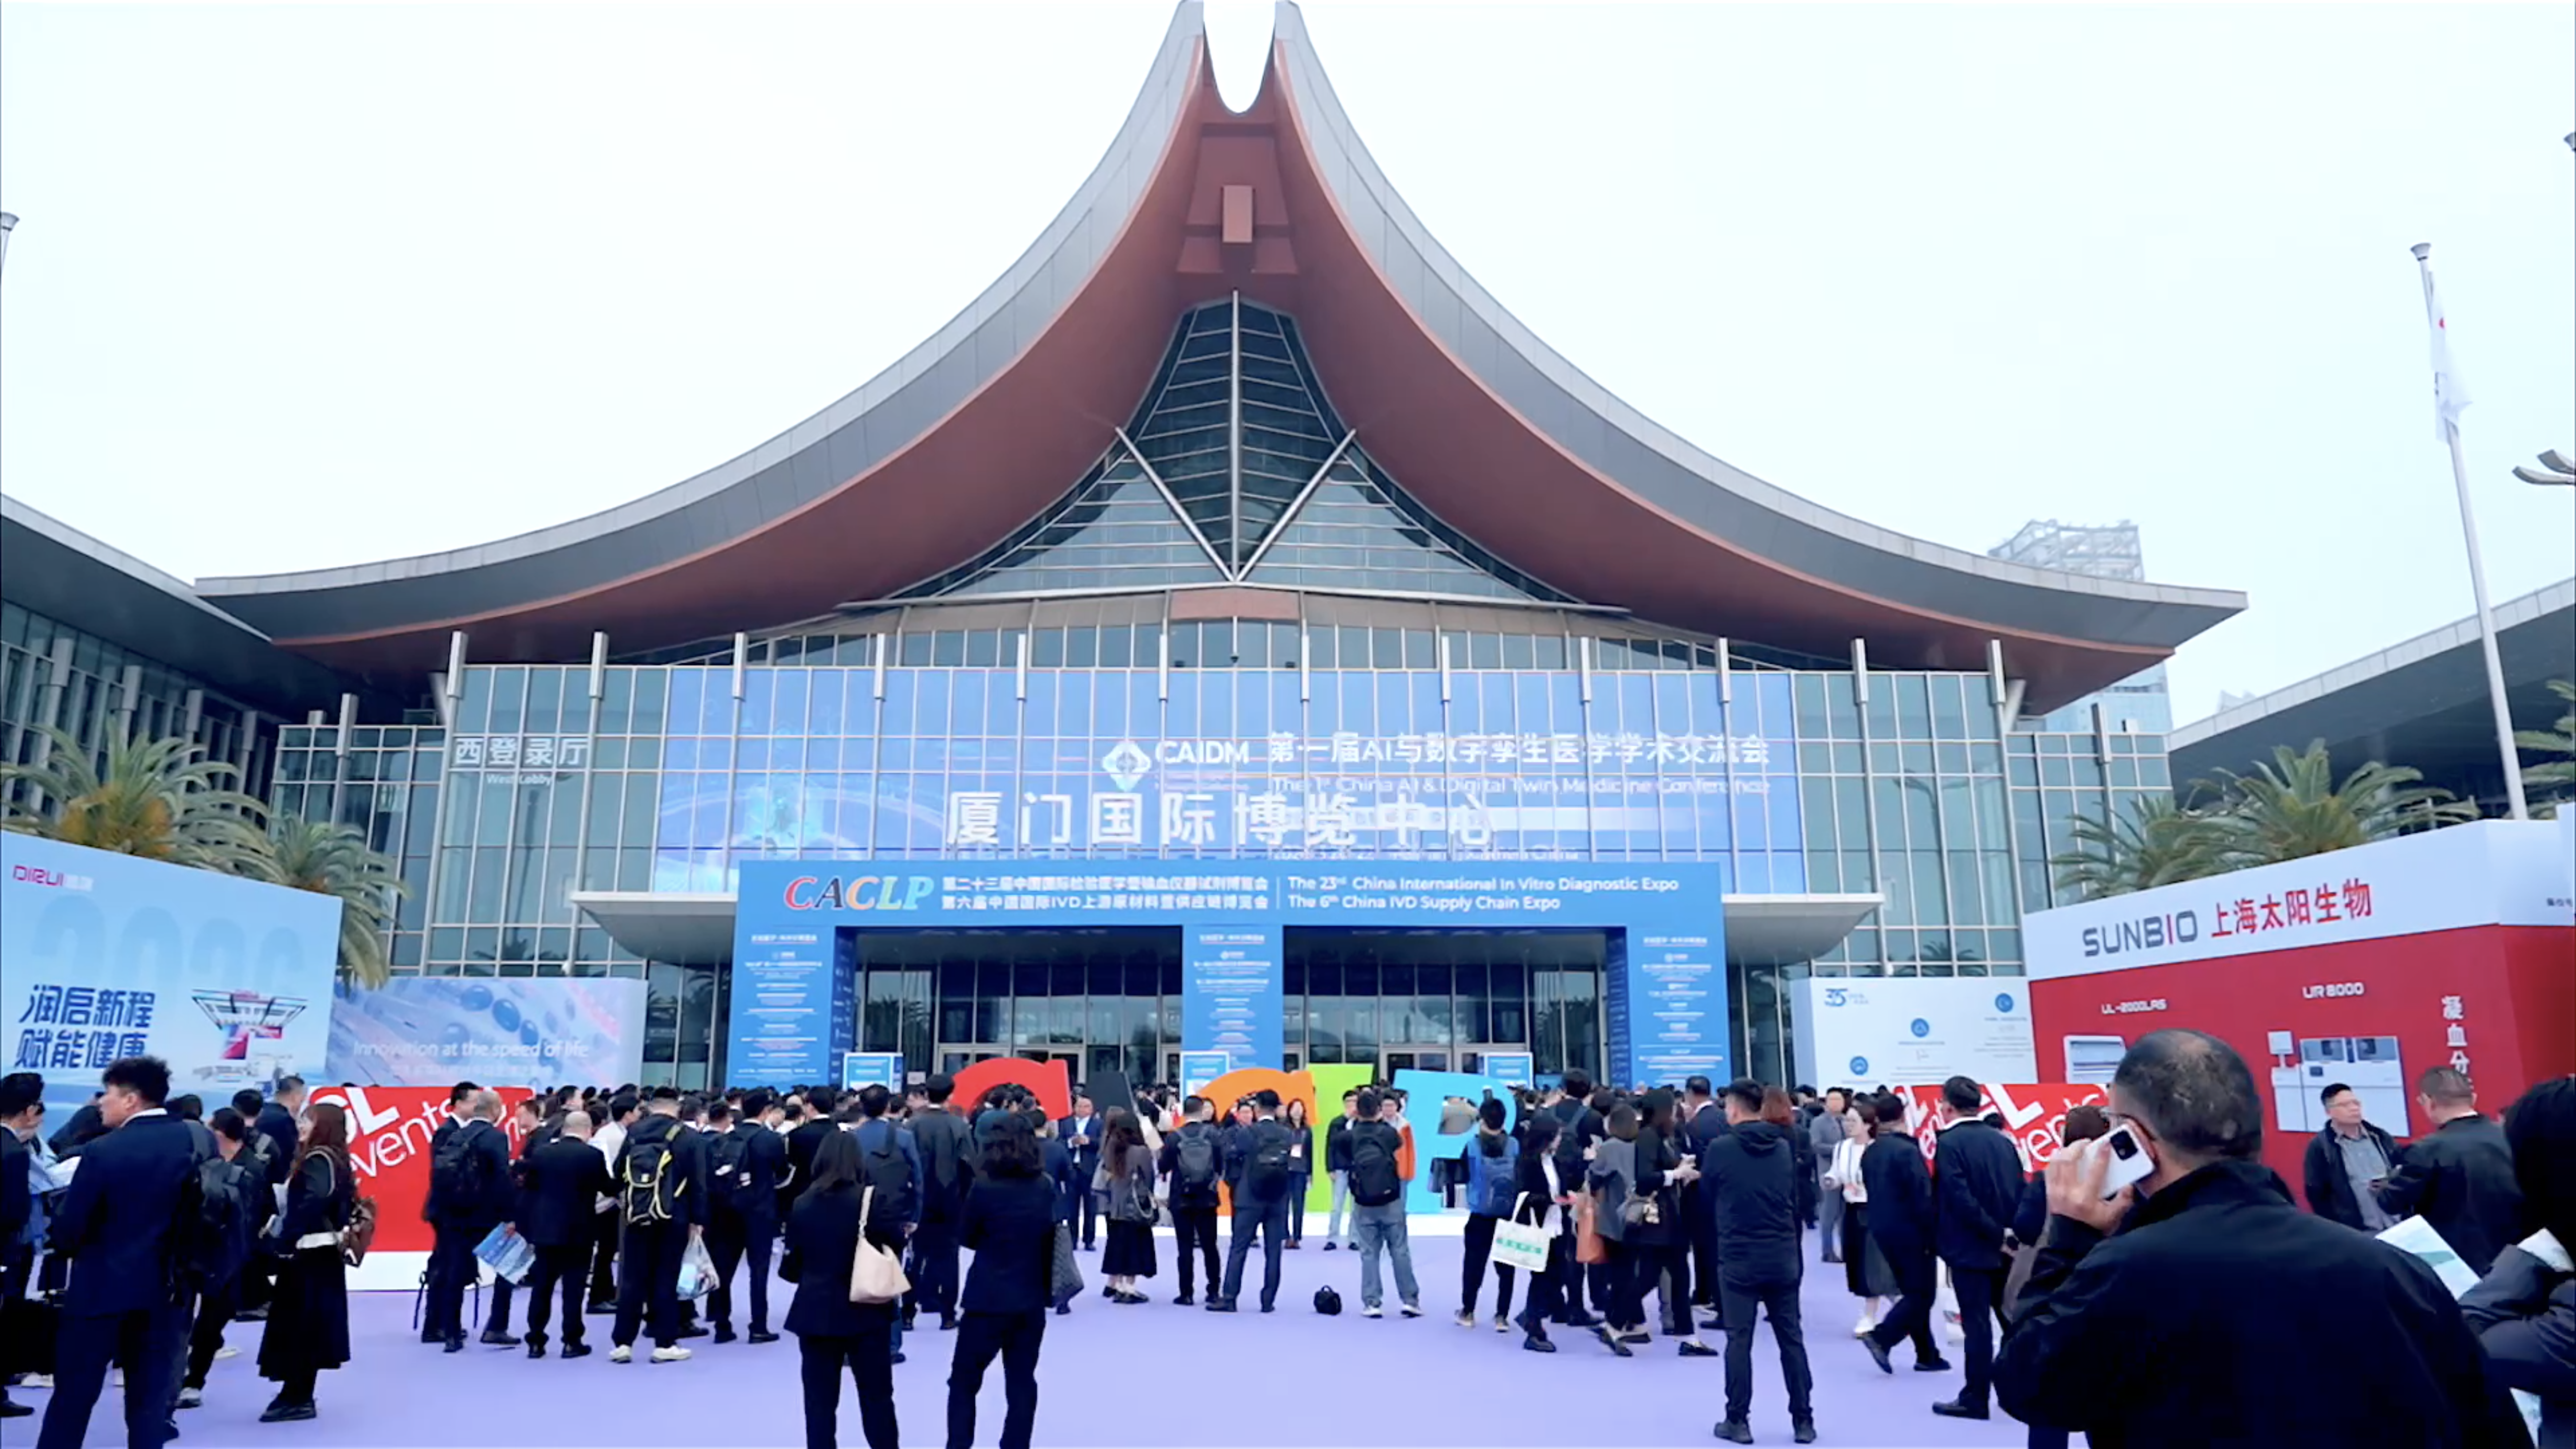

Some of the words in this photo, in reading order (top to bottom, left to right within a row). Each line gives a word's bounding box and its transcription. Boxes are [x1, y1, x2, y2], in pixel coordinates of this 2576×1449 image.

[455, 738, 588, 765] 西登录厅
[1156, 741, 1249, 764] CAIDM
[1273, 777, 1303, 792] The
[1336, 777, 1393, 792] China
[1511, 778, 1558, 793] Twin
[947, 791, 1497, 846] 厦门国际博览中心
[784, 876, 934, 911] CACLP
[1287, 876, 1316, 890] The
[1352, 877, 1396, 890] China
[1400, 876, 1496, 891] International
[1501, 878, 1515, 891] In
[1518, 877, 1555, 891] Vitro
[1559, 876, 1638, 893] Diagnostic
[1642, 877, 1679, 893] Expo
[1287, 895, 1316, 908] The
[1342, 895, 1386, 908] China
[1390, 896, 1417, 908] IVD
[1420, 895, 1472, 912] Supply
[1476, 896, 1519, 909] Chain
[1523, 897, 1561, 912] Expo
[2211, 877, 2372, 938] 上海太阳生物
[2082, 910, 2199, 957] SUNBIO
[19, 984, 155, 1028] 润启新程
[14, 1028, 148, 1069] 赋能健康
[492, 1040, 541, 1059] speed
